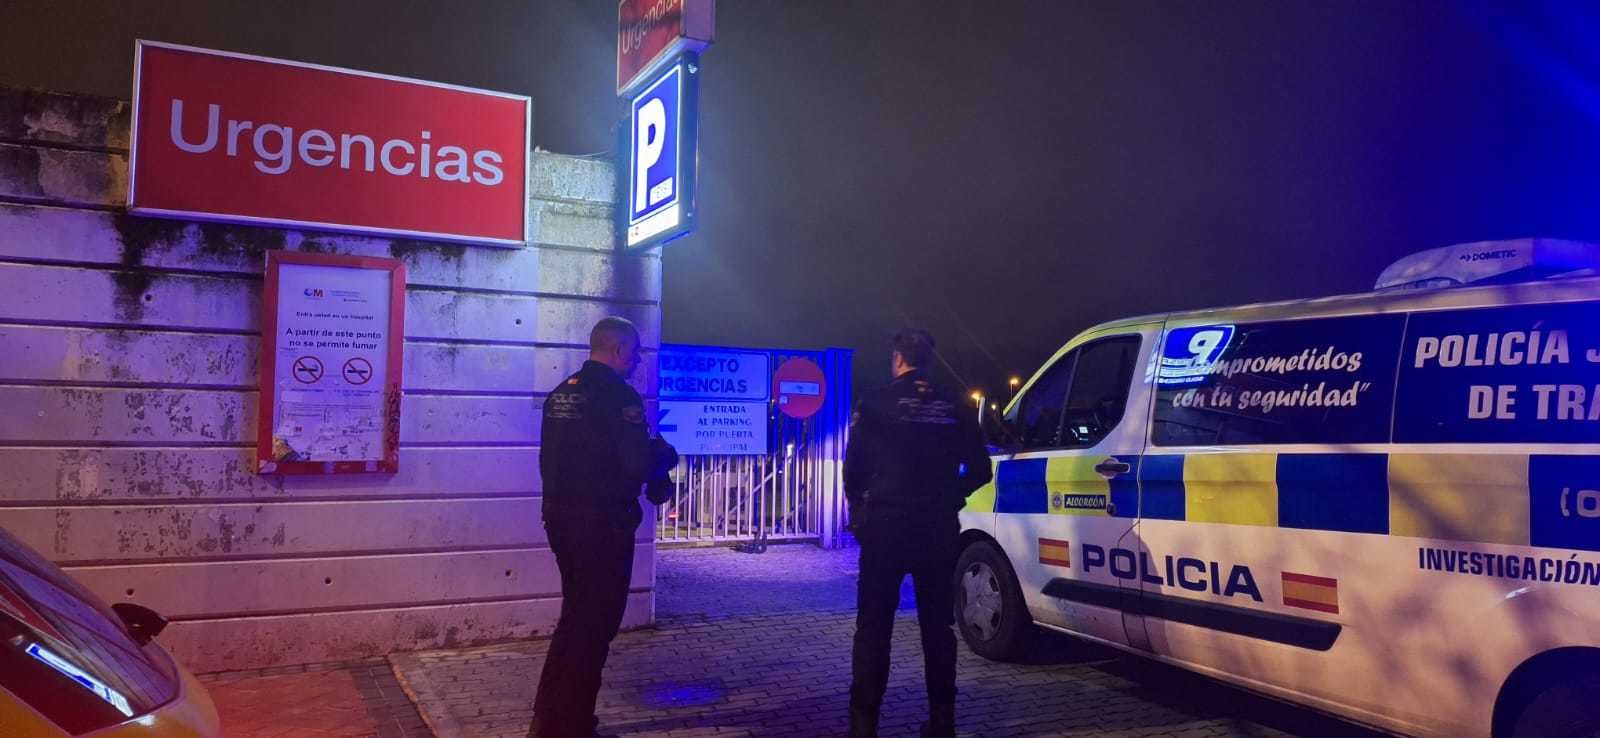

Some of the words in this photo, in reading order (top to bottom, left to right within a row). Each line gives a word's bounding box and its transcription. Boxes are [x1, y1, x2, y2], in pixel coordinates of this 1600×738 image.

[622, 0, 679, 54] Urgencia
[170, 99, 503, 186] Urgencias
[636, 98, 666, 213] P
[1472, 249, 1517, 261] DOMETIC
[286, 327, 293, 335] A
[295, 328, 320, 337] partir
[322, 328, 333, 337] de
[335, 330, 353, 338] este
[356, 331, 382, 340] punto
[316, 340, 350, 349] permite
[352, 341, 378, 350] fumar
[1414, 320, 1569, 368] POLICÍA
[660, 355, 739, 373] EXCEPTO
[1194, 346, 1363, 377] mprometidos
[704, 405, 746, 414] ENTRADA
[1173, 388, 1205, 408] con
[1211, 385, 1232, 408] tu
[1468, 384, 1517, 420] DE
[697, 417, 708, 426] AL
[712, 417, 752, 426] PARKING
[1082, 543, 1264, 602] POLICIA
[1418, 547, 1600, 587] INVESTIGACIÓN
